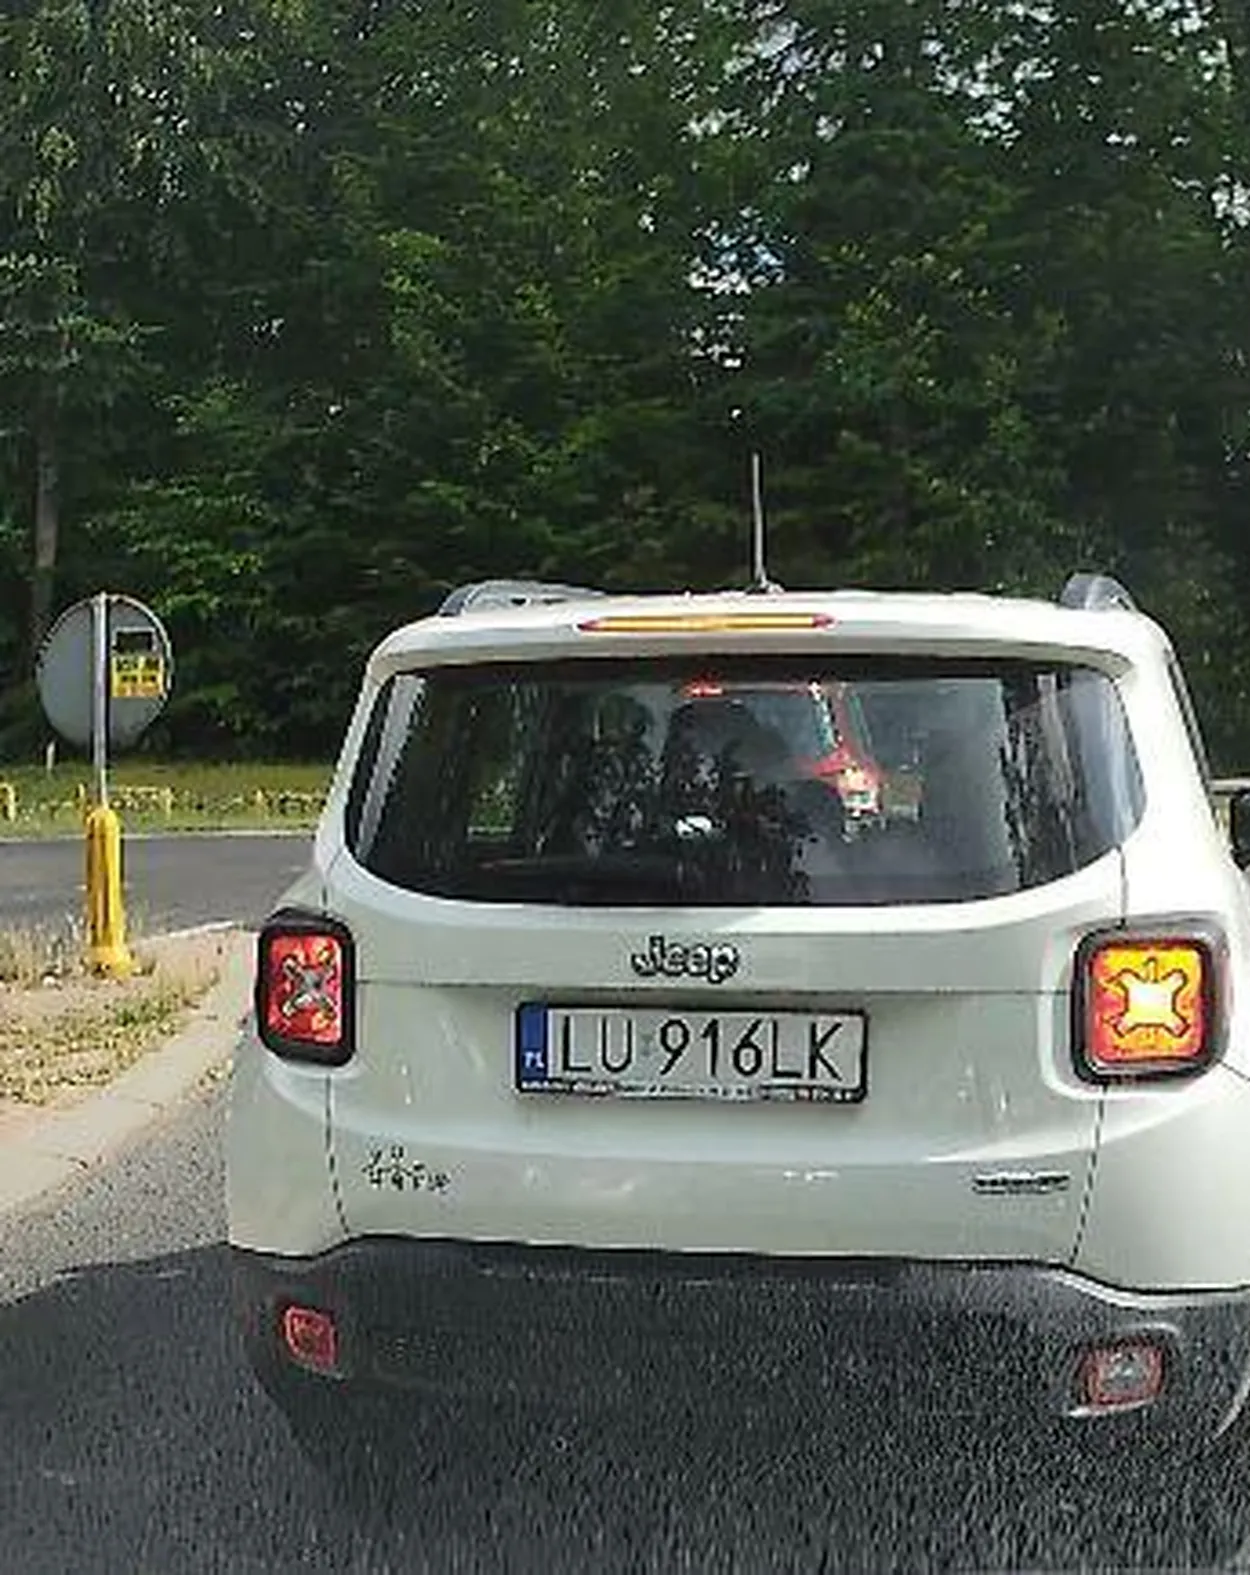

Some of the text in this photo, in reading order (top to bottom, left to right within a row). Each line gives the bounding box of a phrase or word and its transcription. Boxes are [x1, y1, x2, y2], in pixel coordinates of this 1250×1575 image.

[631, 935, 741, 985] Jeep
[562, 1015, 843, 1082] LU 916LK
